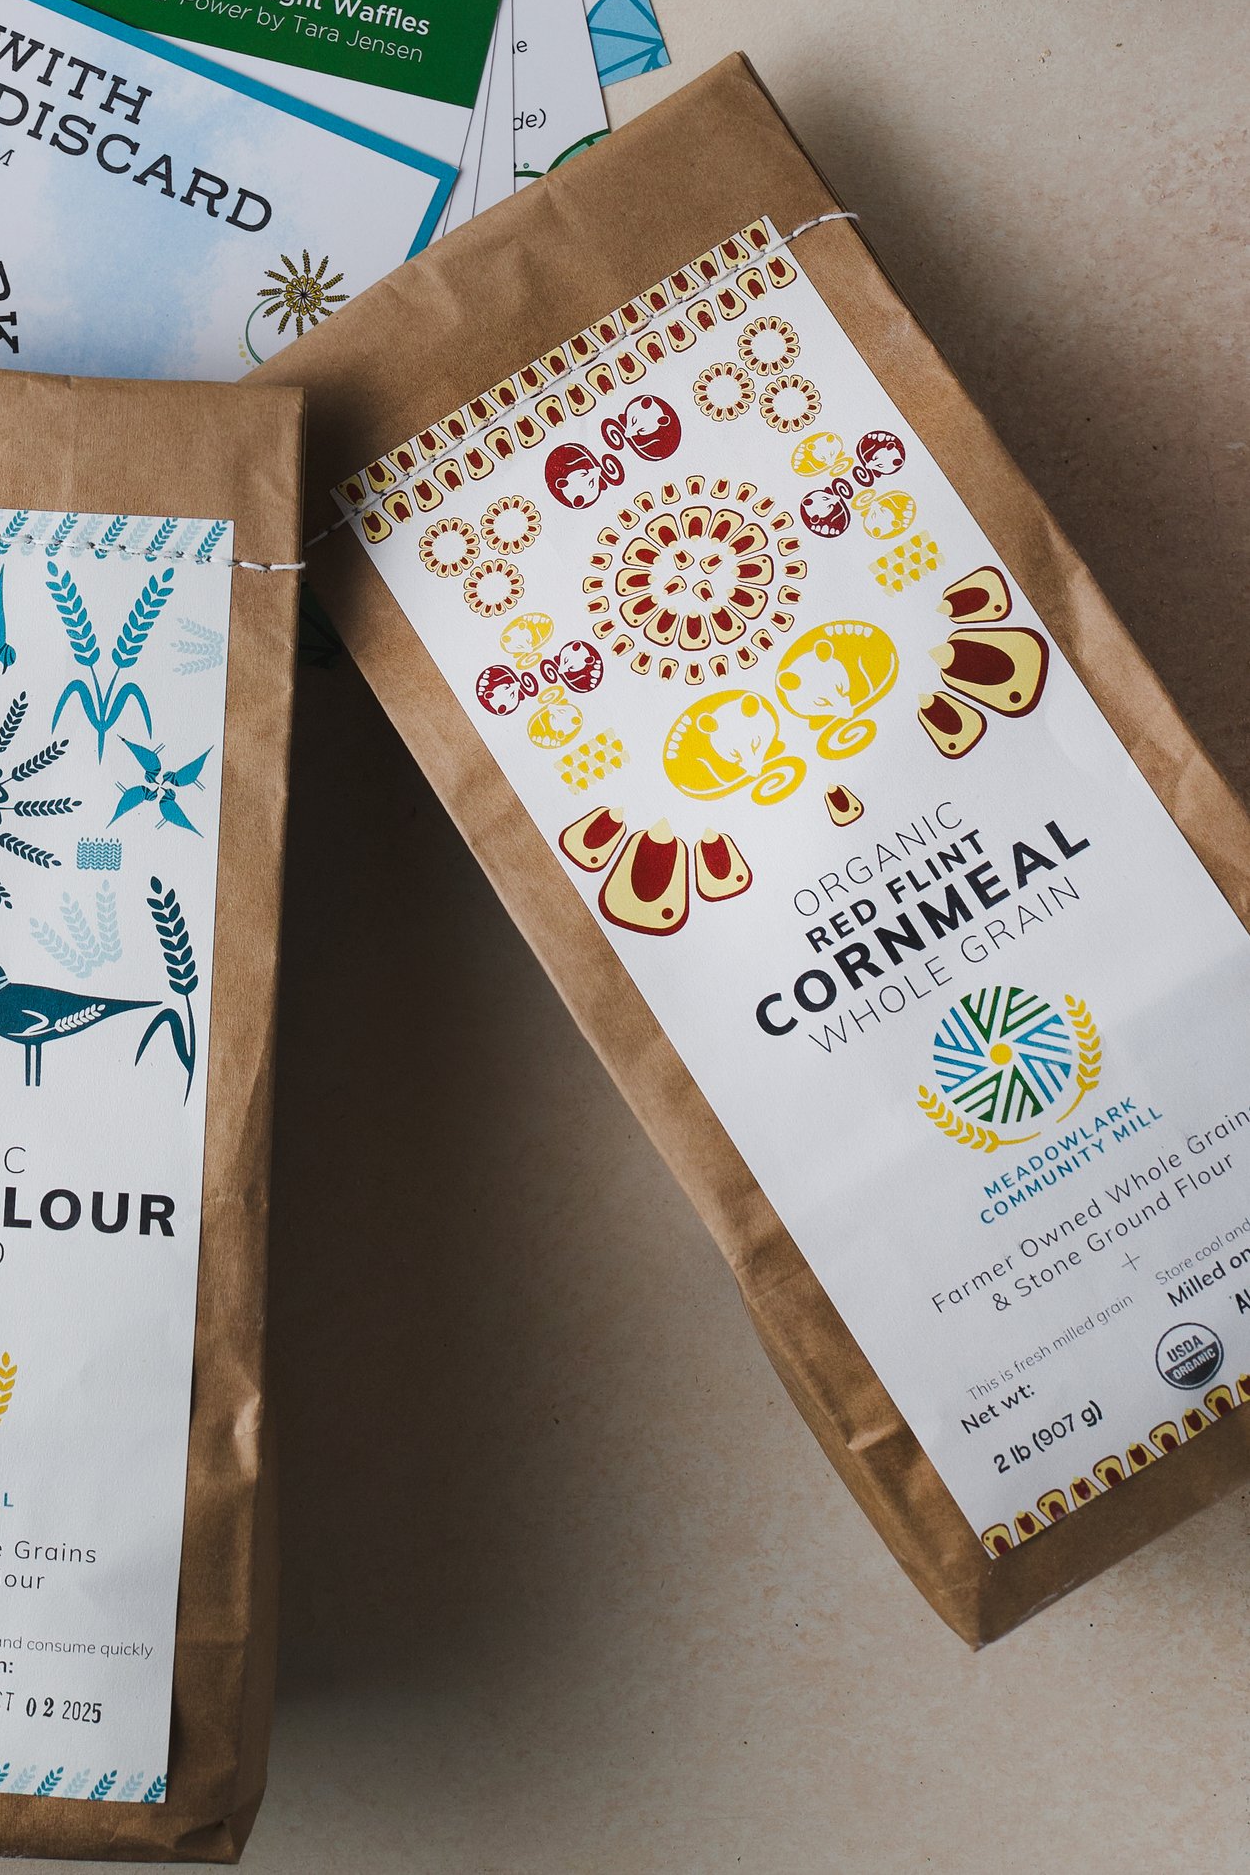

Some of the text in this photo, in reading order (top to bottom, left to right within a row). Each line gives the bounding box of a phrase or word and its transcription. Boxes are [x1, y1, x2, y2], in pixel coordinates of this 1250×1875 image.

[257, 6, 286, 33] by
[294, 13, 343, 44] Tara
[346, 29, 423, 62] Jensen
[794, 807, 962, 916] ORGANIC
[805, 829, 984, 951] RED FLINT
[756, 821, 1091, 1036] CORNMEAL
[808, 876, 1080, 1053] WHOLE GRAIN
[980, 1107, 1163, 1224] COMMUNITY MILL
[984, 1097, 1137, 1198] MEADOWLARK
[15, 1540, 96, 1563] Grains
[27, 1641, 95, 1654] consume
[101, 1642, 153, 1660] quickly
[62, 1700, 102, 1724] 2025
